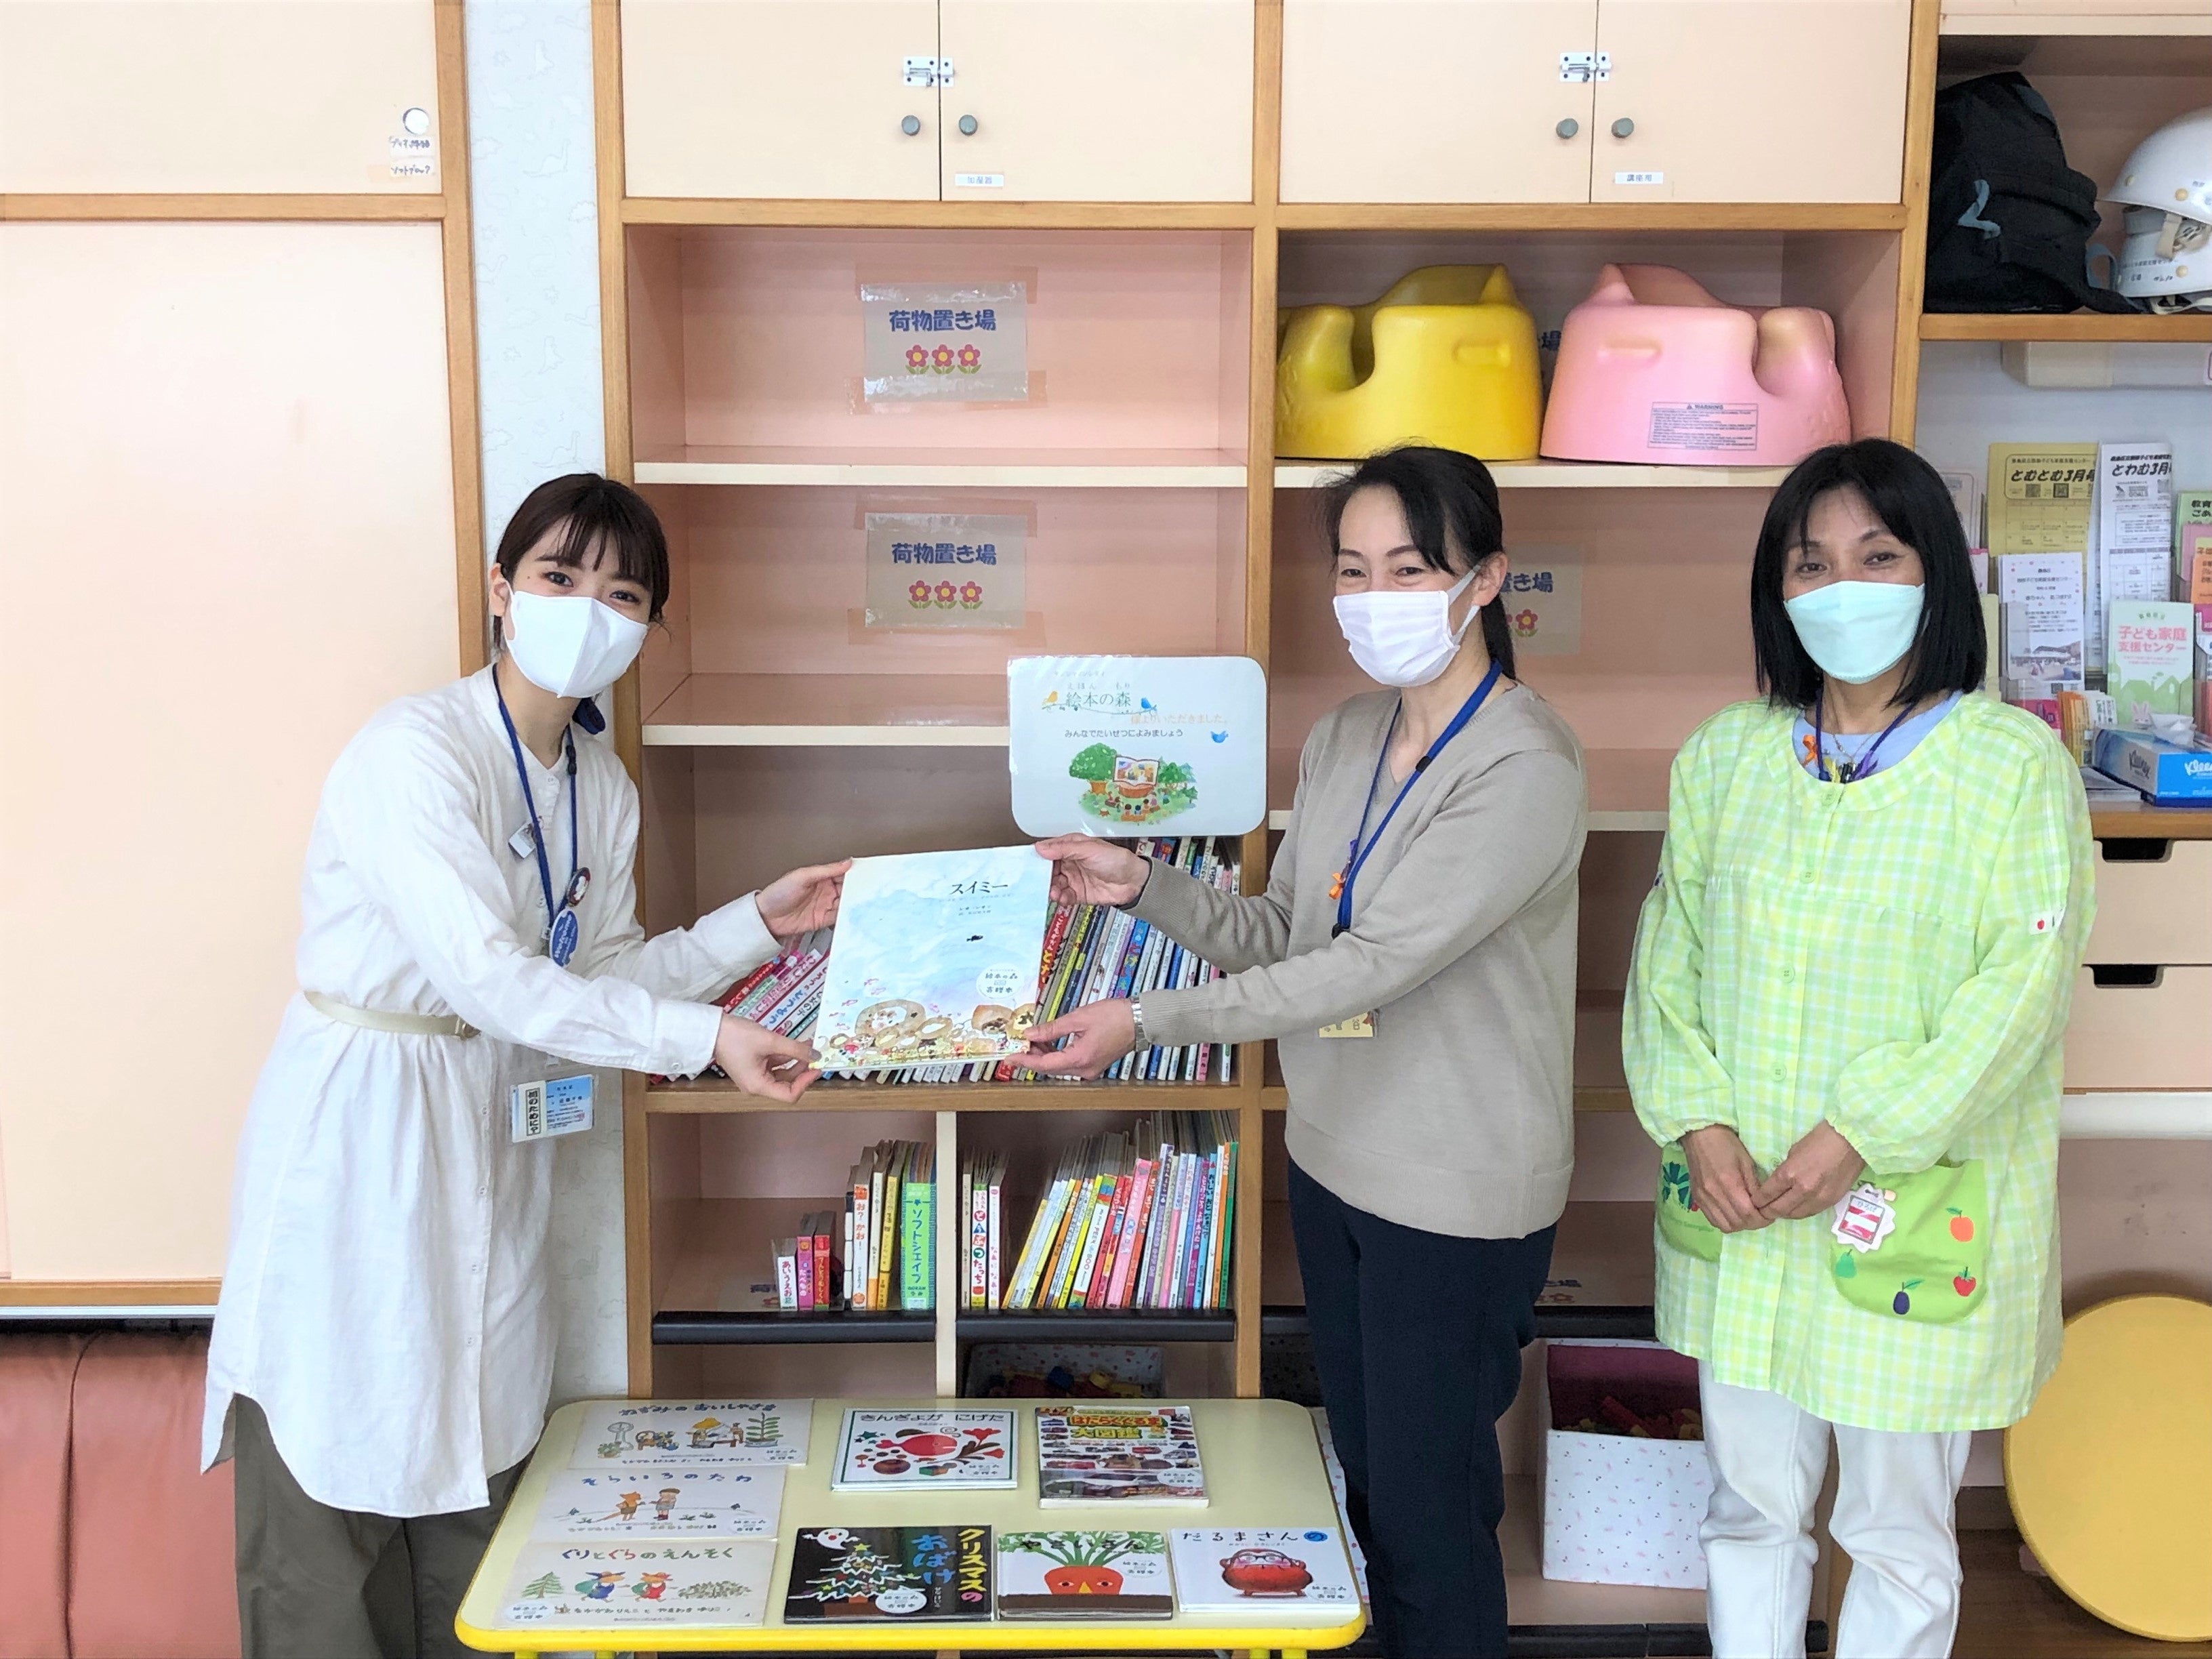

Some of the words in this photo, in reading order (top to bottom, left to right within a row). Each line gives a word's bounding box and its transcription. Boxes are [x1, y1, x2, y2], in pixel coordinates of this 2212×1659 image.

[889, 309, 996, 331] 荷物置き場
[2111, 462, 2172, 476] とわむ3月
[891, 543, 997, 565] 荷物置き場
[2118, 625, 2187, 641] 子ども家庭
[2118, 642, 2186, 653] 支援センター
[1066, 691, 1131, 708] 絵本の森
[949, 880, 1008, 895] スイミー
[1071, 1415, 1161, 1425] はたらくくるま
[1070, 1427, 1142, 1439] 大図鑑
[562, 1547, 733, 1560] ぐりとぐらのえんそく
[911, 1534, 957, 1584] おばけ
[958, 1528, 987, 1602] クリスマスの
